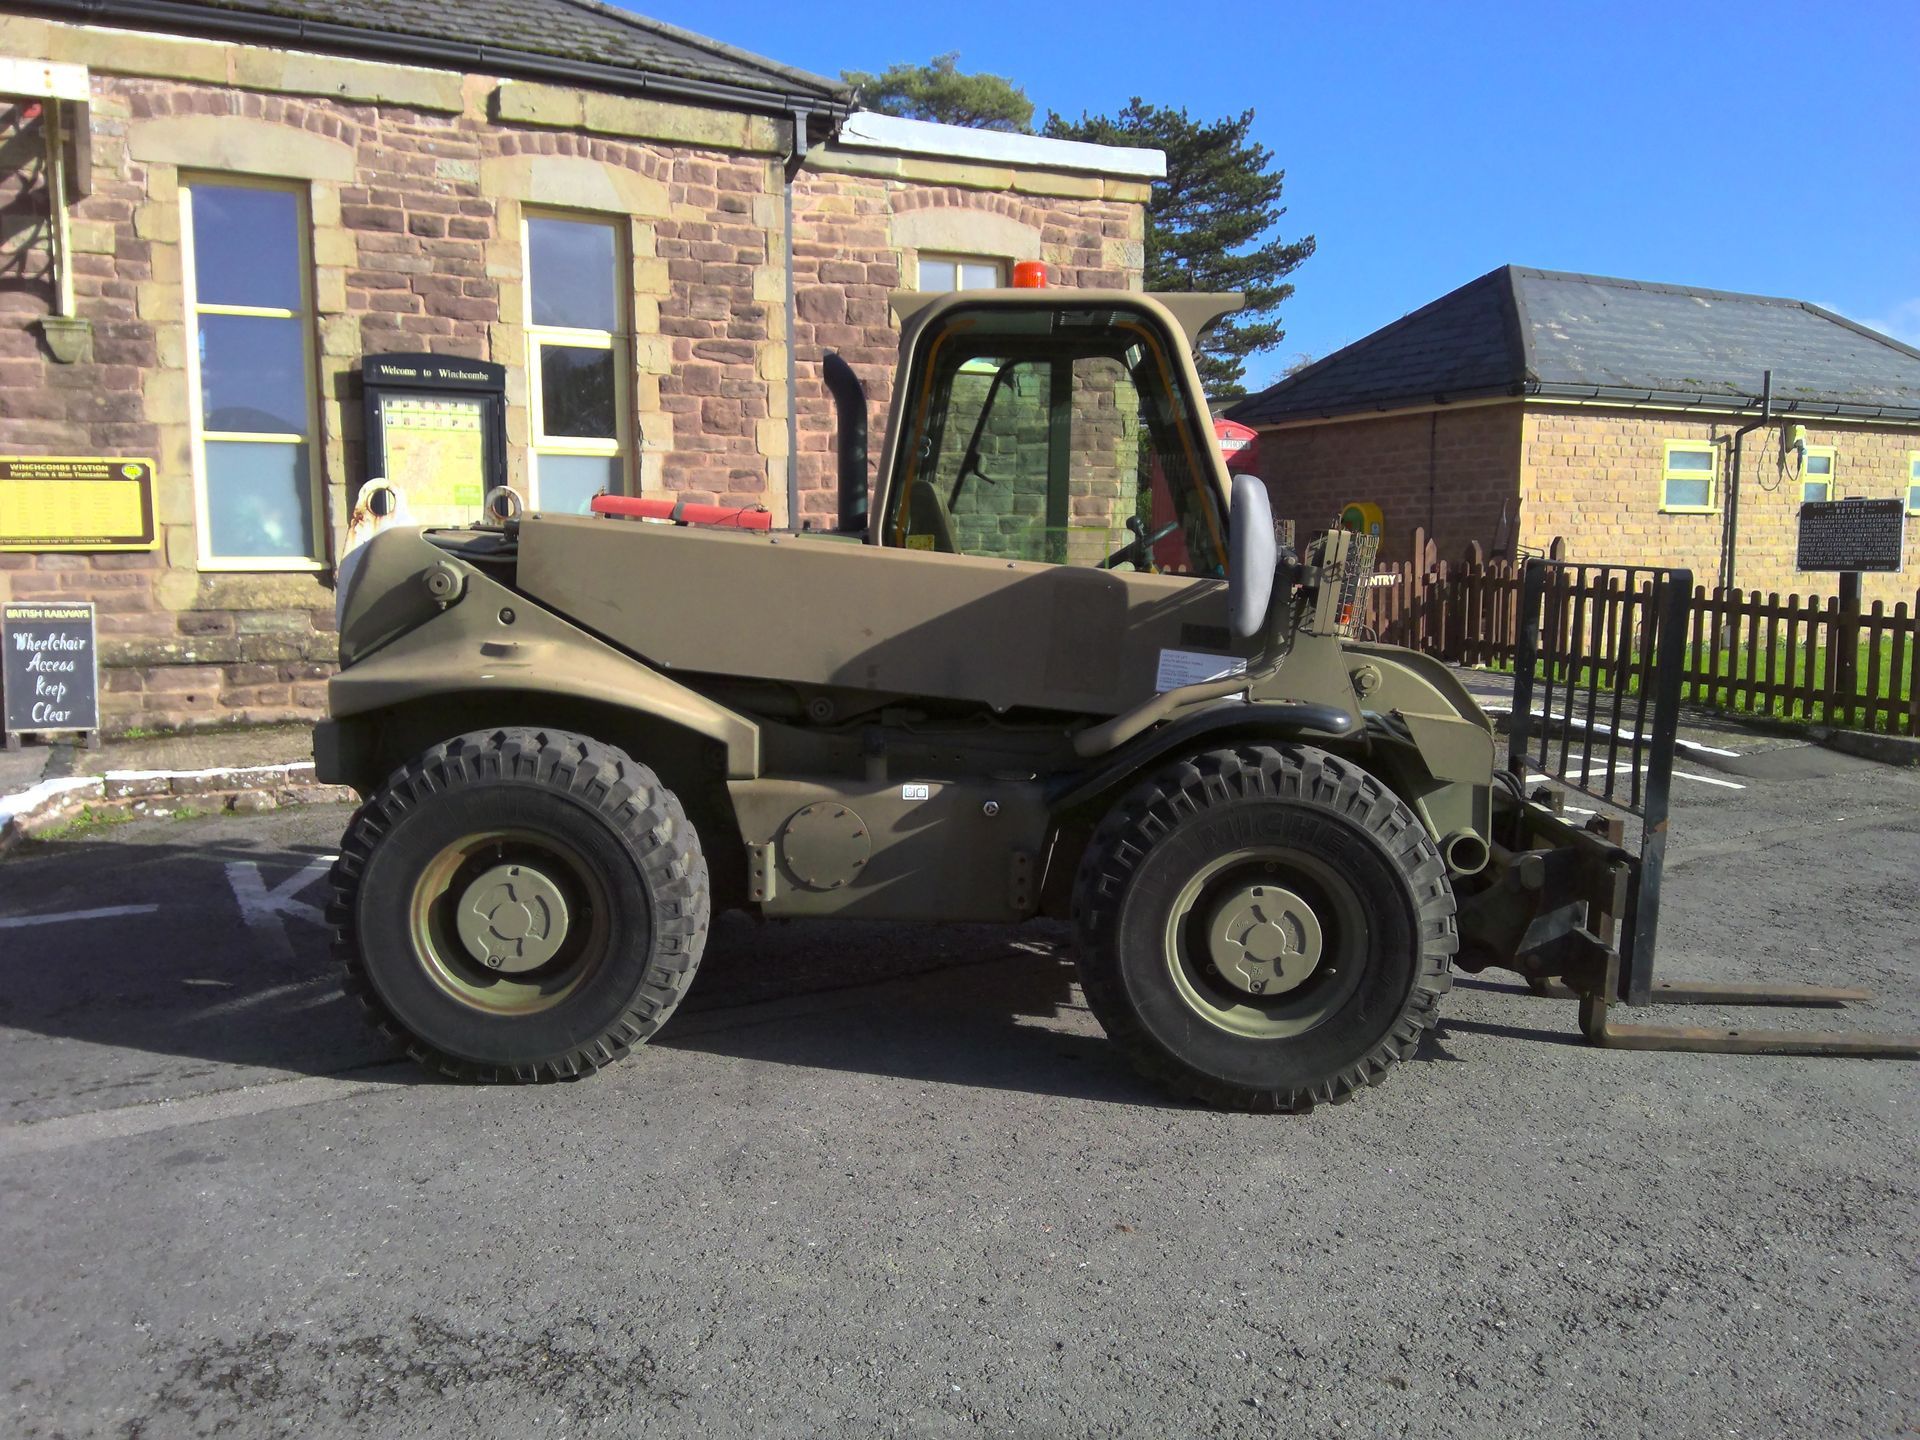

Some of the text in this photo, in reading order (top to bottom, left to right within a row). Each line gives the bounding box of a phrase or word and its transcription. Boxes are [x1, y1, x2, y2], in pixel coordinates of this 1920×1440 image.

[380, 365, 489, 381] Welcome to Winchcombe
[72, 464, 109, 472] STATION
[6, 609, 90, 619] BRITISH RAILWAYS
[13, 632, 86, 651] Wheelchair
[25, 652, 75, 672] Access
[32, 701, 71, 723] Clear
